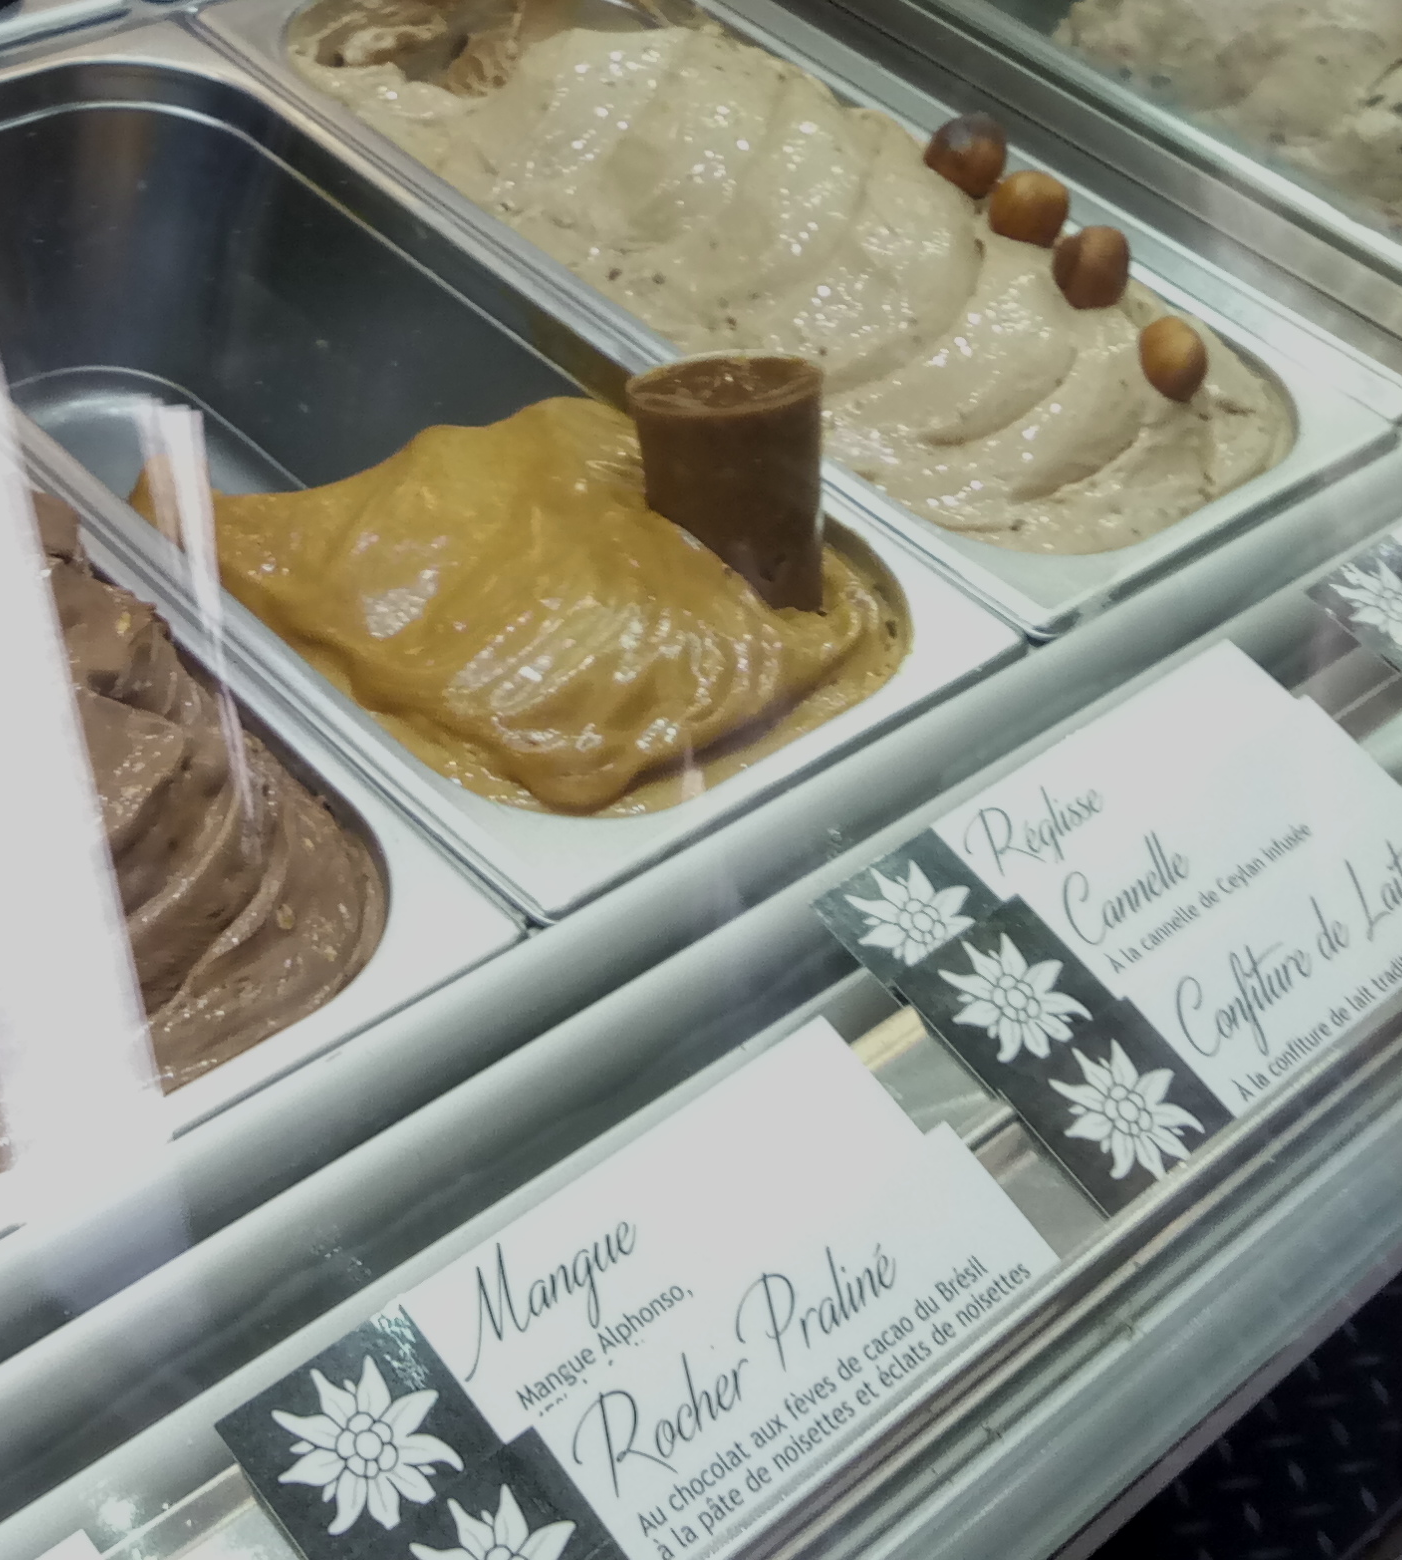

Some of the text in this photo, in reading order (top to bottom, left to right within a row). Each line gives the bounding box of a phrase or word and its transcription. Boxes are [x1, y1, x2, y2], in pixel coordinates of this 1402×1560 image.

[964, 785, 1104, 877] Réglisse
[1063, 830, 1189, 946] Cannelle
[1119, 947, 1142, 964] la
[1139, 906, 1199, 952] cannelle
[1198, 890, 1220, 909] de
[1216, 857, 1267, 895] Ceylan
[1176, 944, 1312, 1058] Confiture
[1310, 895, 1350, 961] de
[1246, 1071, 1271, 1091] la
[1268, 1021, 1333, 1077] confiture
[1328, 1005, 1351, 1027] de
[1345, 985, 1377, 1011] lait
[465, 1221, 636, 1382] Mangue
[516, 1348, 597, 1411] Mangue
[597, 1285, 694, 1355] Alphonso,
[573, 1352, 749, 1498] Rocher
[735, 1243, 896, 1373] Praliné
[637, 1255, 989, 1537] Au chocolat aux fèves de cacao du Brésil
[670, 1517, 699, 1548] la
[697, 1489, 745, 1536] pâte
[746, 1463, 773, 1492] de
[773, 1407, 856, 1472] noisettes
[855, 1382, 880, 1406] et
[878, 1341, 932, 1388] éclats
[931, 1321, 957, 1347] de
[955, 1263, 1032, 1329] noisettes
